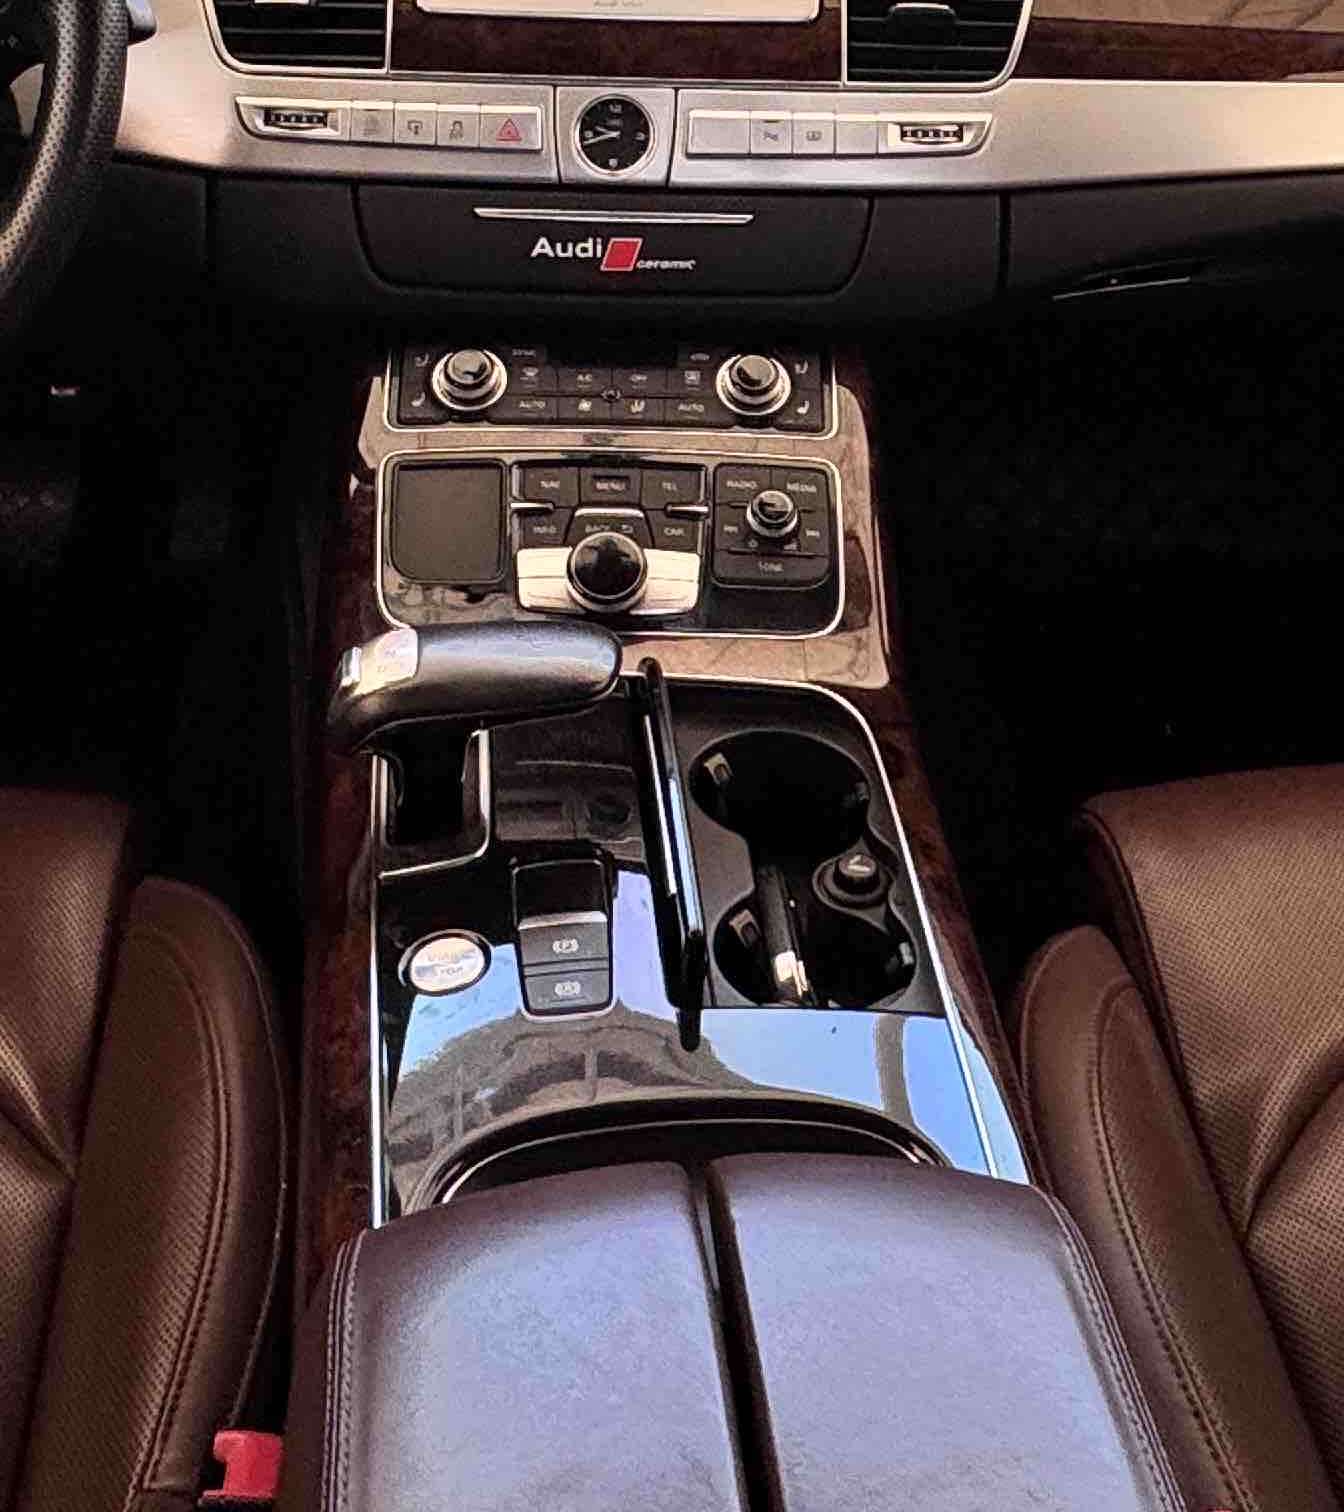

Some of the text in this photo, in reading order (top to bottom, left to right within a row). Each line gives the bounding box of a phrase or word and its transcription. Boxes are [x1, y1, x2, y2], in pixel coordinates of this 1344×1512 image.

[530, 237, 696, 270] Audi ceramic
[519, 399, 546, 409] AUTO
[678, 402, 705, 413] AUTO
